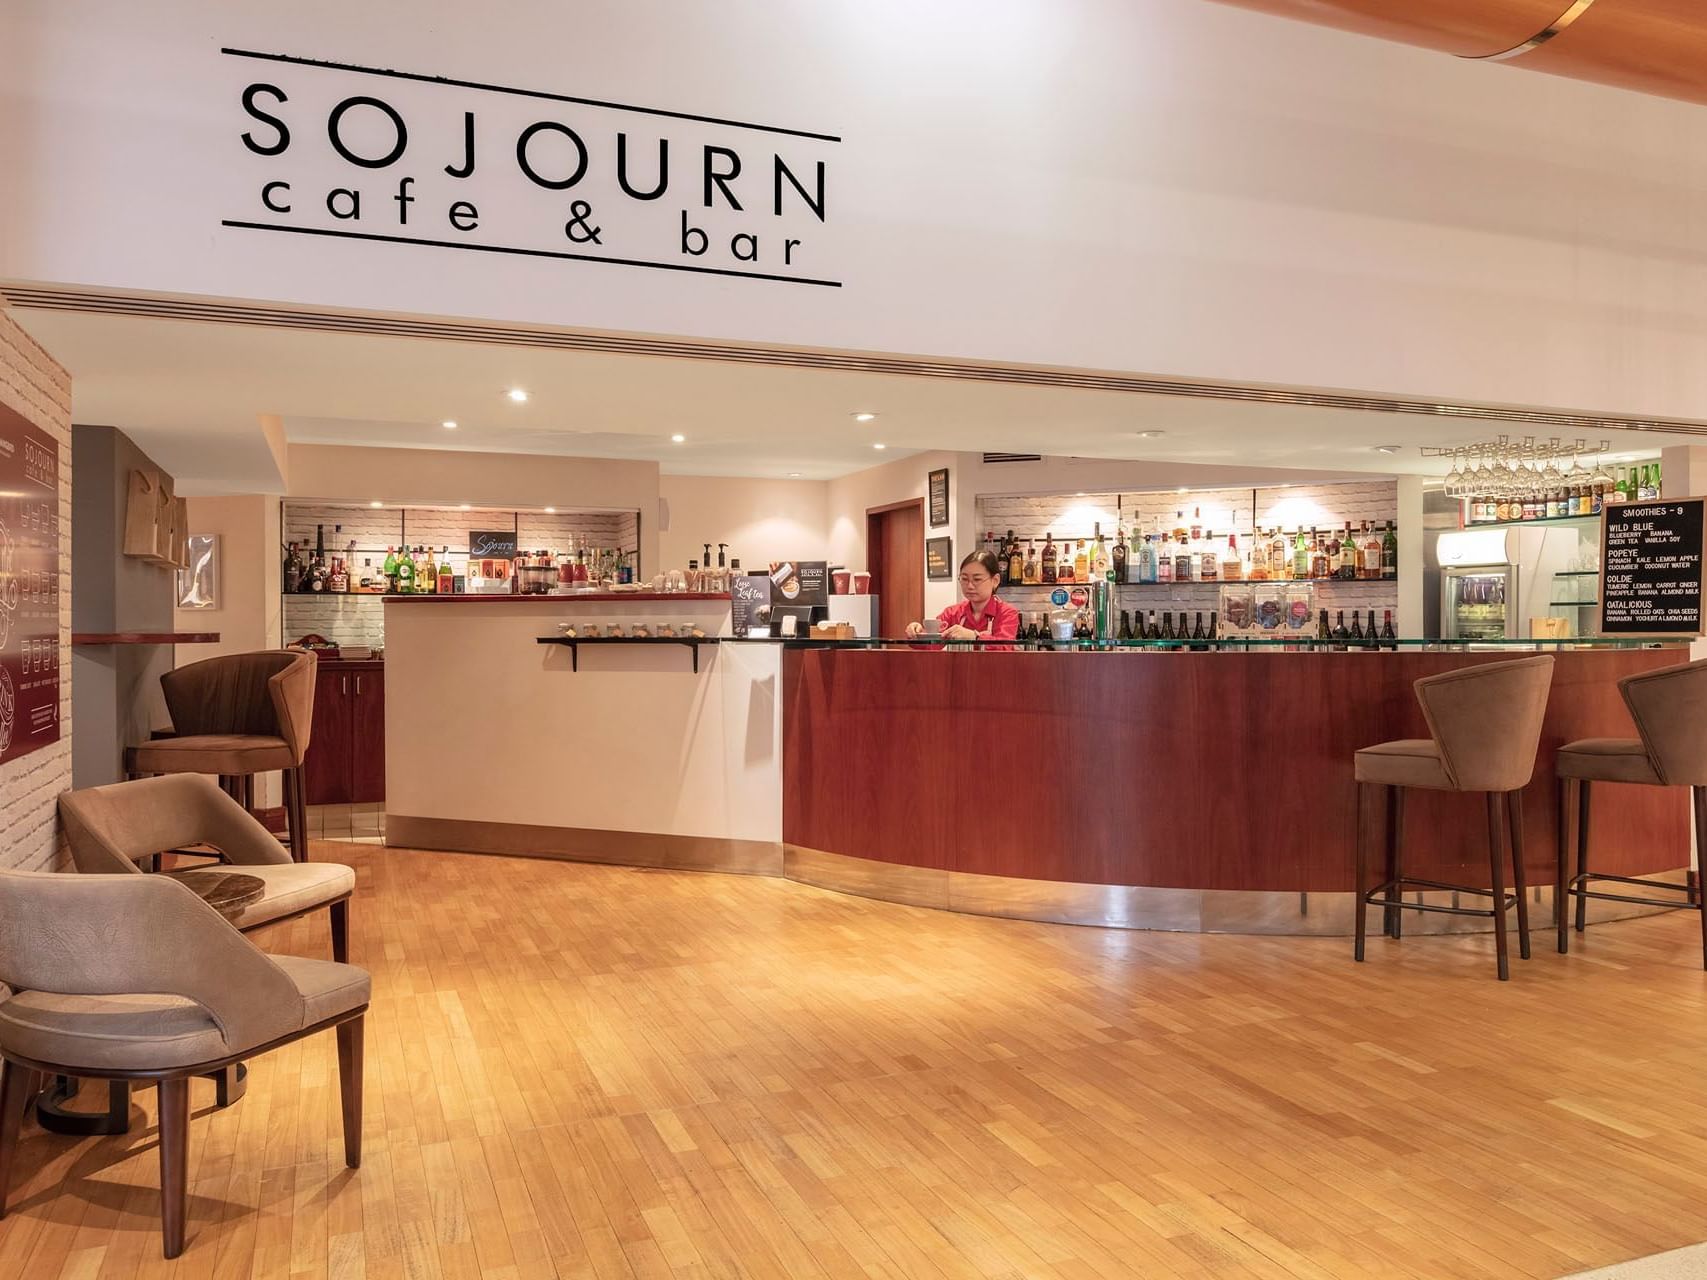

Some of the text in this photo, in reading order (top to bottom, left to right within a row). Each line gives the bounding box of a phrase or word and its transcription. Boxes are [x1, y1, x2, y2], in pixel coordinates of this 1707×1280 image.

[240, 83, 826, 223] SOJOURN
[261, 176, 803, 266] cafe & bar
[25, 442, 55, 473] SOJOURN
[1622, 508, 1667, 518] SMOOTHIES
[1677, 506, 1684, 515] 9
[1609, 523, 1655, 532] WILD BLUE
[1608, 549, 1639, 557] POPEYE
[1607, 601, 1653, 609] OATALICIOUS
